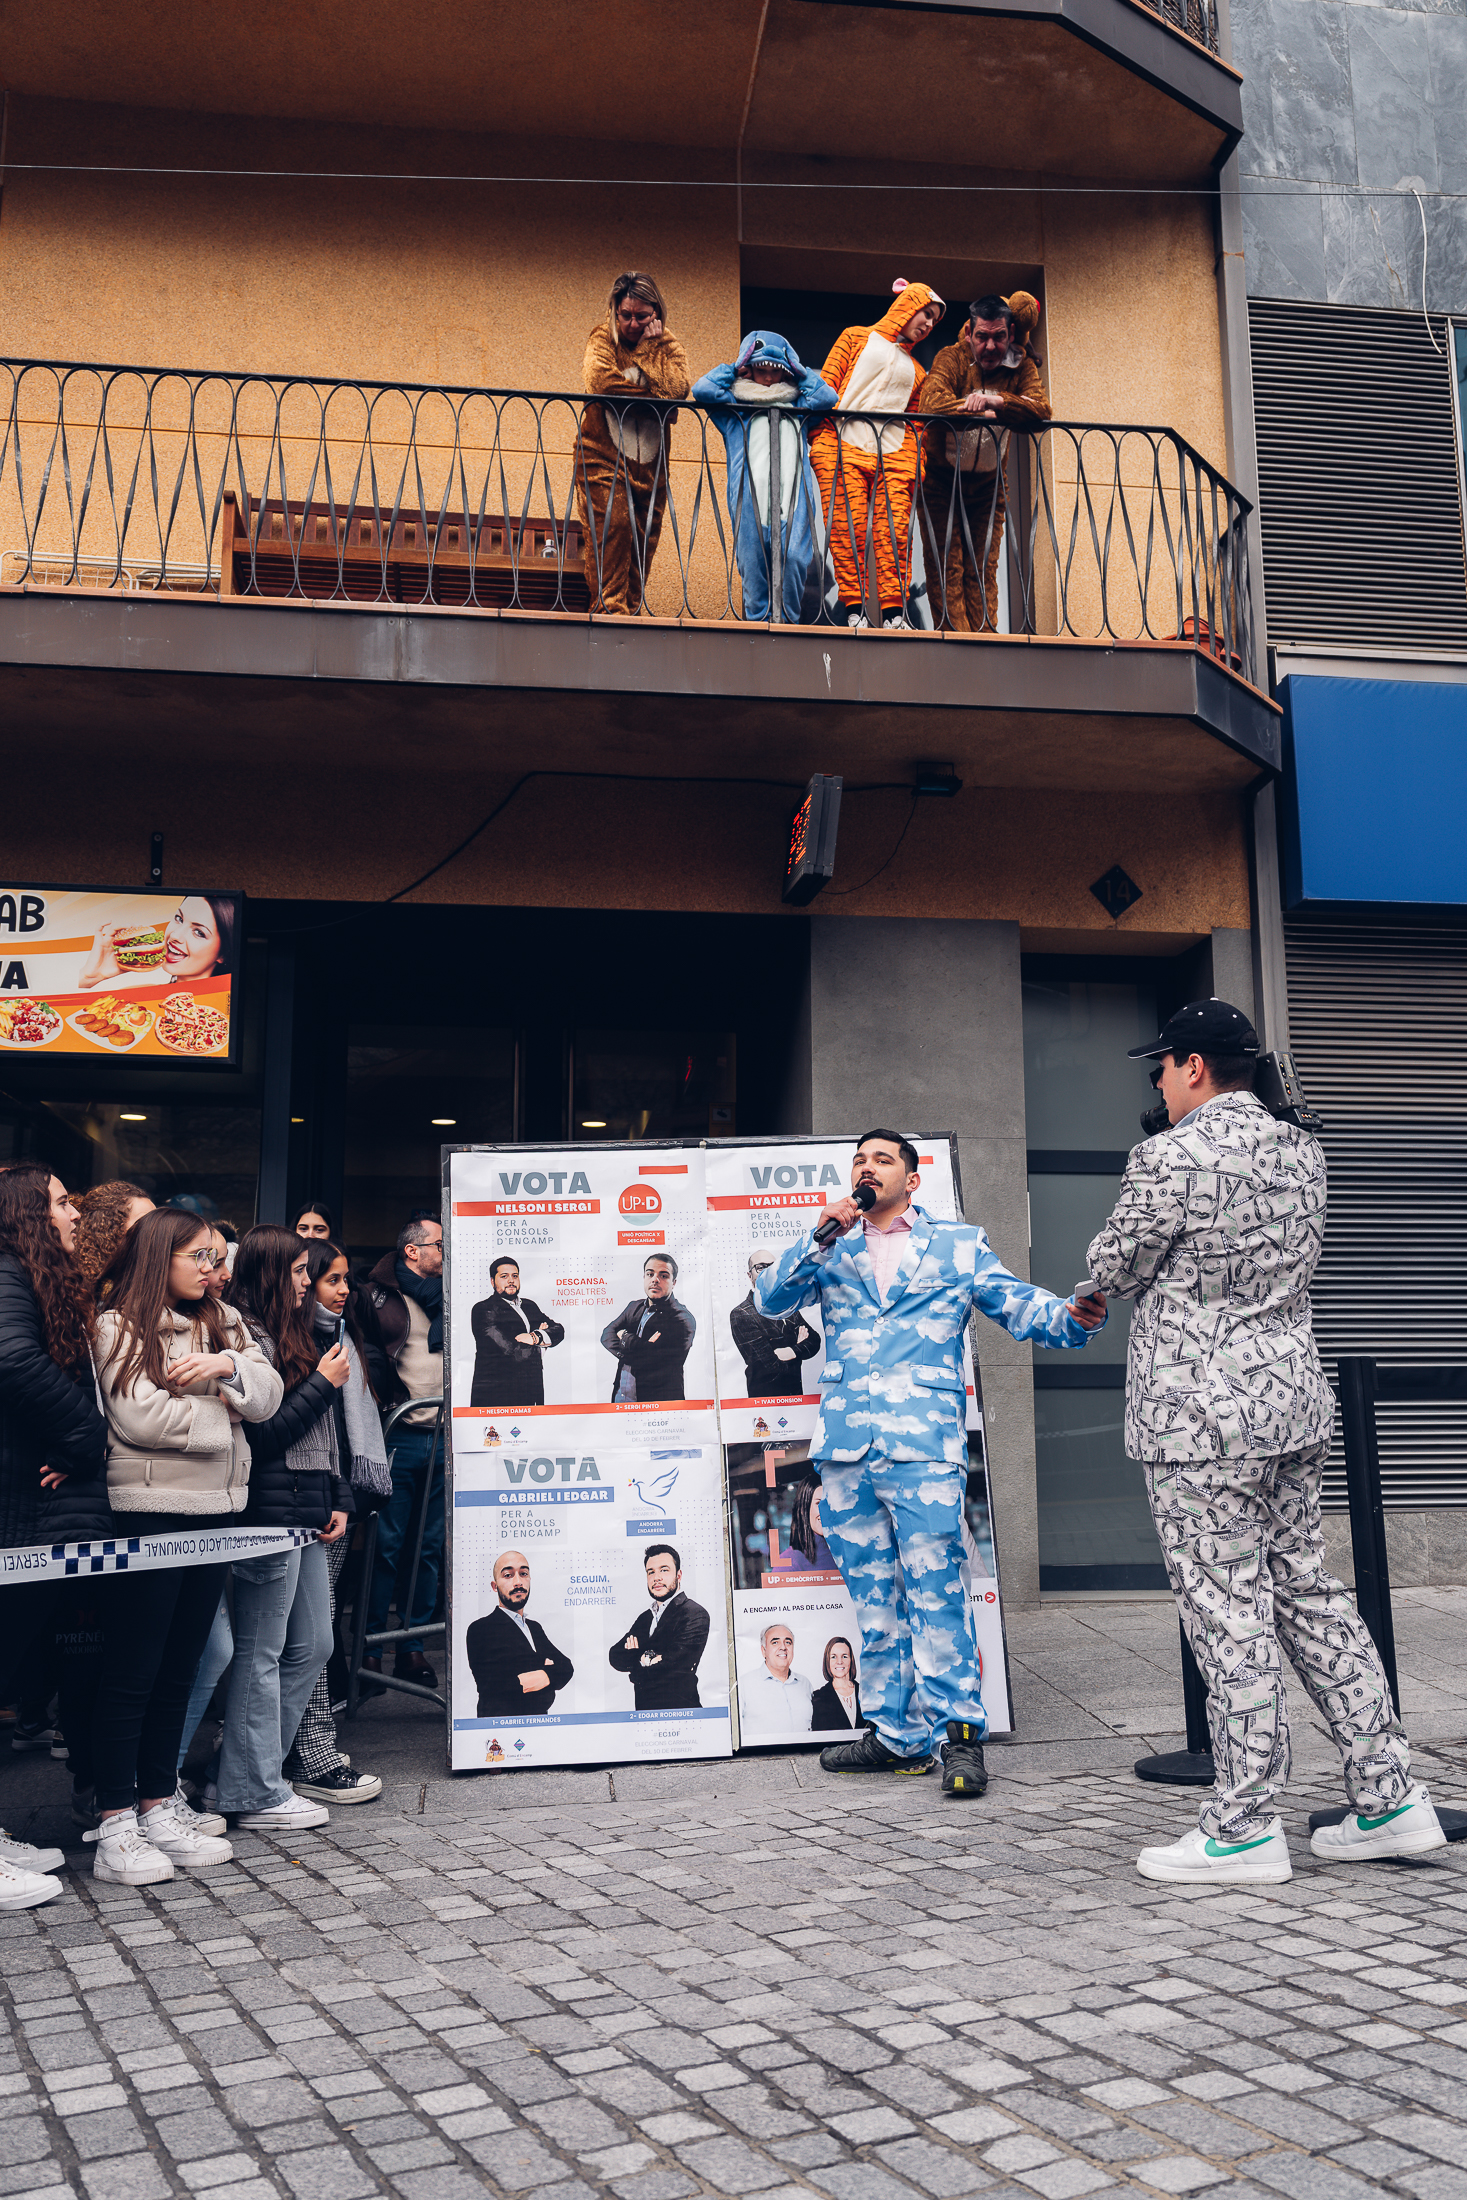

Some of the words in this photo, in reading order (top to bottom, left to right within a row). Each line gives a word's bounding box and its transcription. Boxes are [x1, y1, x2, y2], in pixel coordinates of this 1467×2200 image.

[1105, 879, 1131, 903] 14
[749, 1164, 841, 1189] VOTA
[499, 1172, 592, 1195] VOTA
[749, 1196, 780, 1206] IVAN
[783, 1196, 787, 1204] I
[790, 1194, 820, 1204] ALEX
[495, 1204, 545, 1213] NELSON
[548, 1204, 552, 1212] I
[554, 1203, 592, 1212] SERGI
[751, 1220, 802, 1229] CONSOLS
[496, 1228, 548, 1236] CONSOLS
[558, 1288, 606, 1296] NOSALTRES
[503, 1457, 601, 1483] VOTA
[498, 1492, 554, 1503] GABRIEL
[557, 1492, 561, 1501] I
[564, 1490, 608, 1501] EDGAR
[502, 1510, 522, 1518] PER
[501, 1519, 555, 1528] CONSOLS
[501, 1529, 560, 1538] D'ENCAMP
[145, 1539, 196, 1557] COMUNAL
[3, 1553, 47, 1571] SERVEI
[570, 1575, 610, 1583] SEGUIM.
[768, 1576, 780, 1584] UP
[567, 1586, 613, 1595] CAMINANT
[565, 1597, 616, 1606] ENDARRERE
[63, 1645, 103, 1654] ANDORRA
